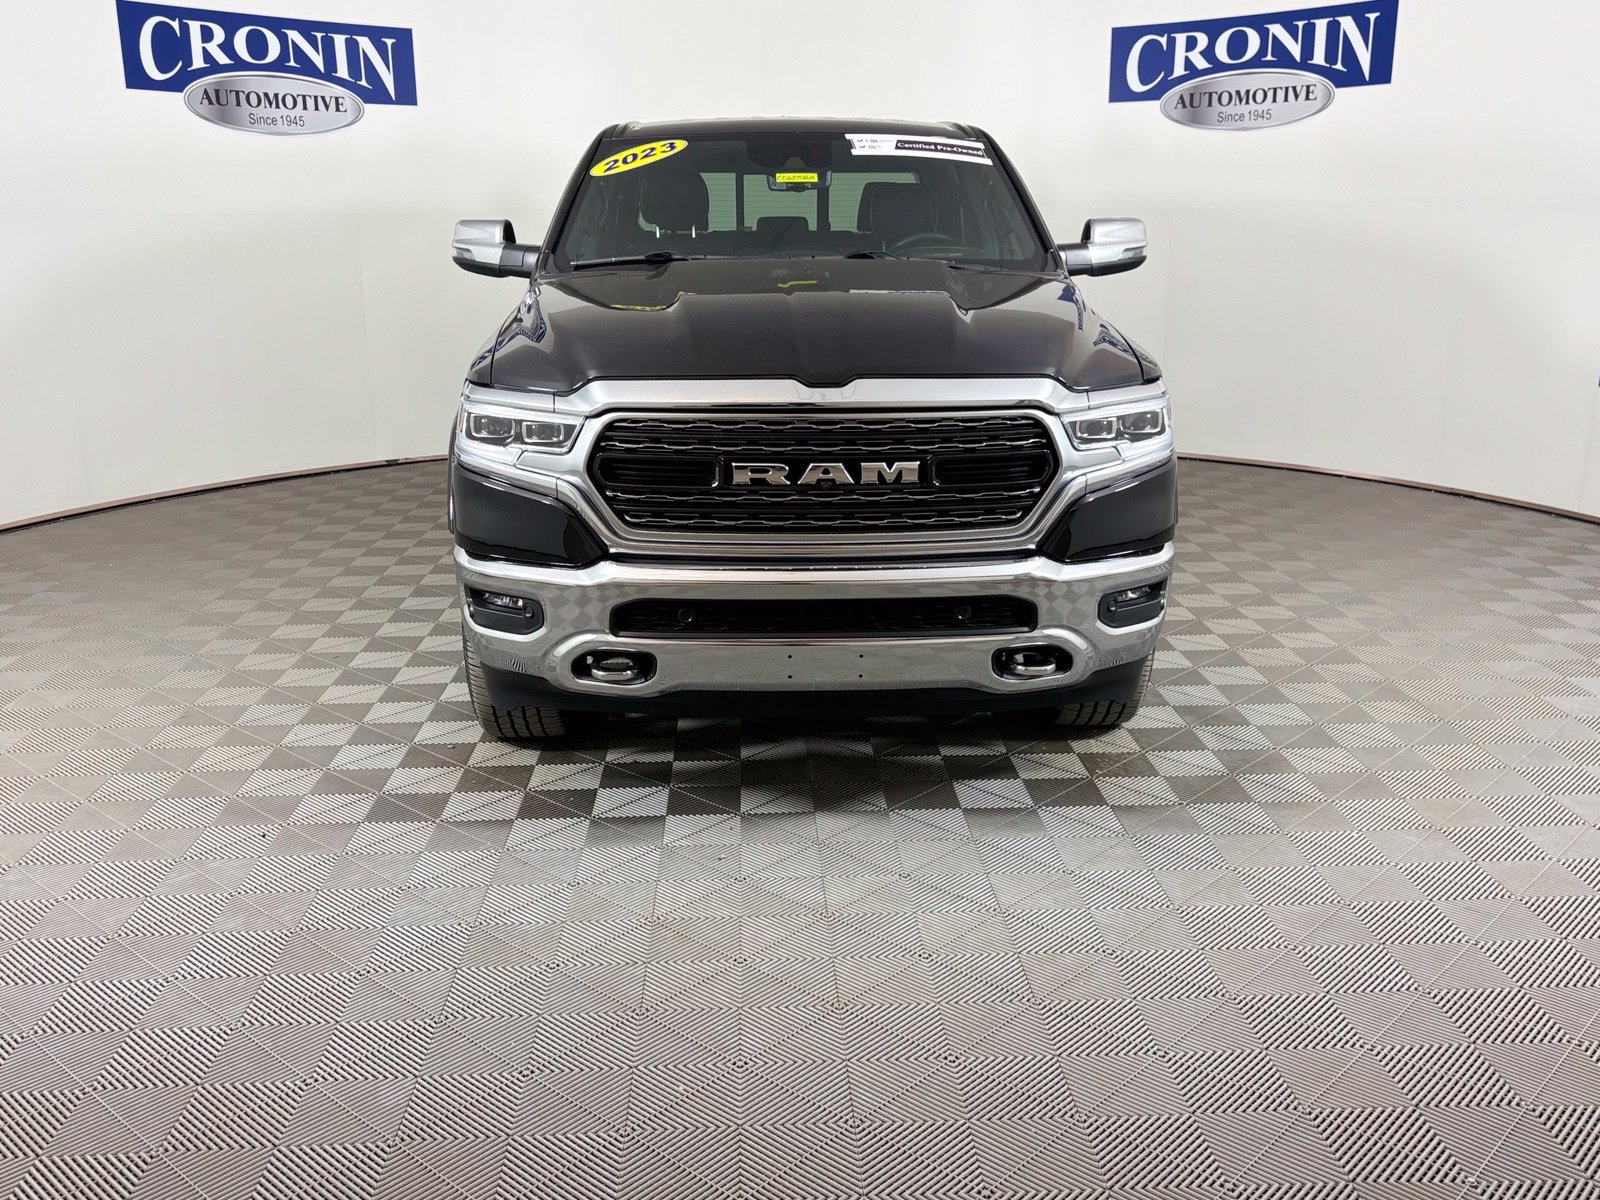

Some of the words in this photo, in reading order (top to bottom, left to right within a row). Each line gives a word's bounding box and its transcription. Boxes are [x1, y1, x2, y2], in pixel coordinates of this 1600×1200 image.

[139, 15, 396, 102] CRONIN
[1125, 11, 1381, 93] CRONIN
[199, 87, 348, 113] AUTOMOTIVE
[1173, 84, 1318, 110] AUTOMOTIVE
[248, 113, 278, 126] Since
[280, 115, 305, 127] 1945
[1216, 111, 1245, 123] Since
[1247, 109, 1272, 121] 1945
[603, 142, 677, 173] 2023
[897, 142, 936, 150] Certified
[936, 145, 983, 156] Pre-Owned
[732, 461, 920, 485] RAM
